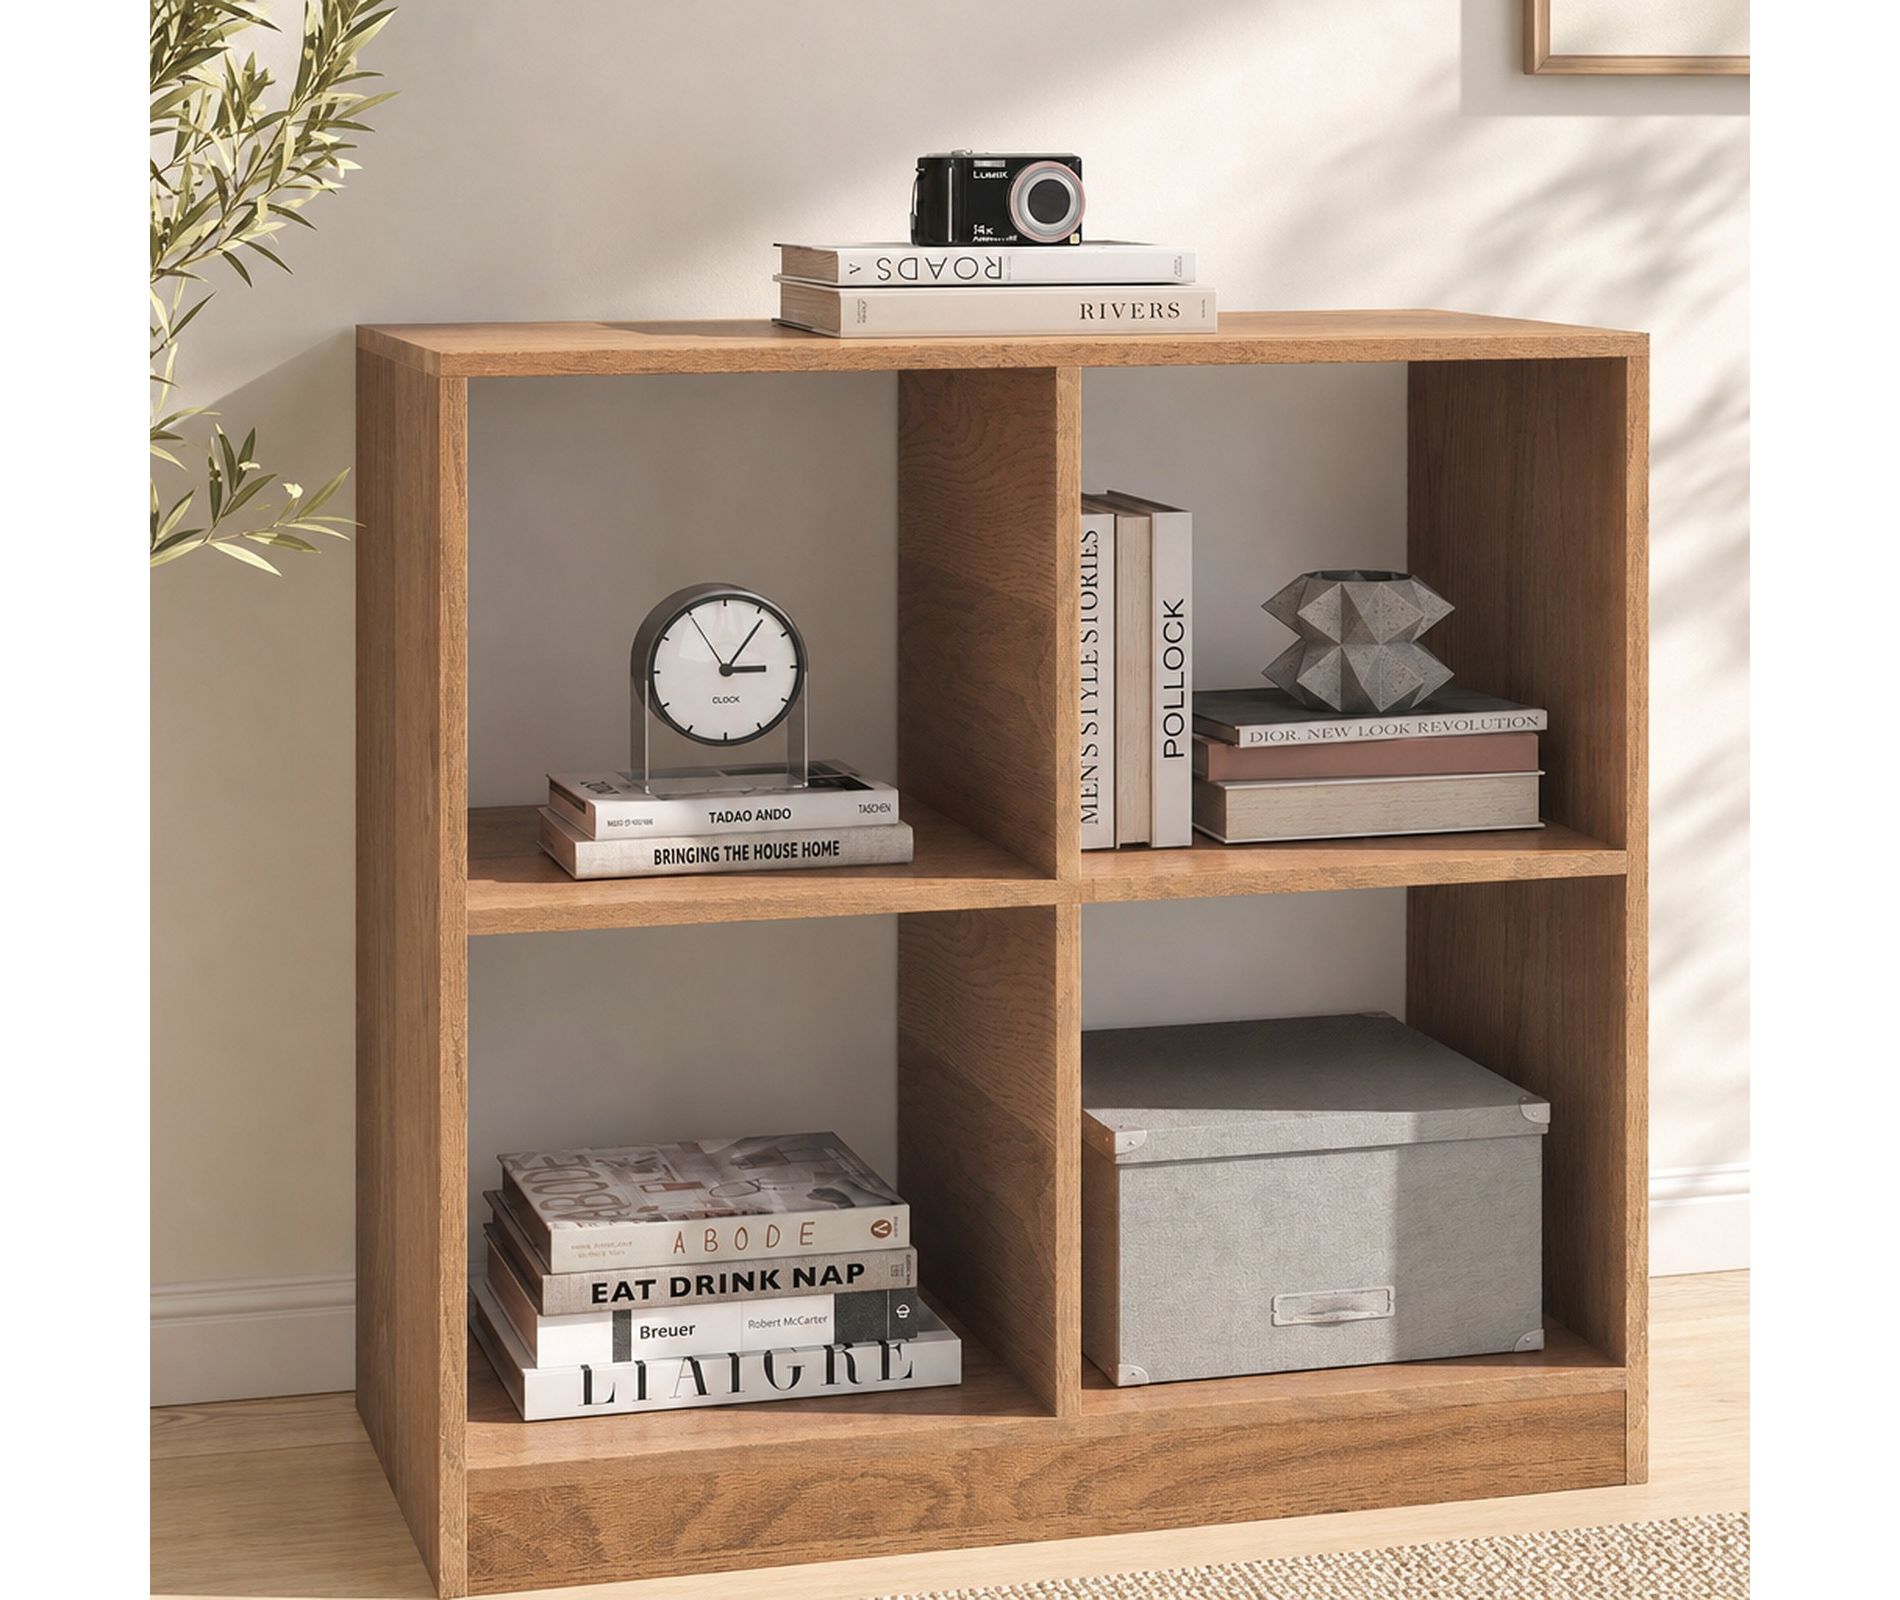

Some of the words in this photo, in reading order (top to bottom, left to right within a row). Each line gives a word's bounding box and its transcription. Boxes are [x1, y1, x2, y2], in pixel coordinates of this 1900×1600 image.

[876, 256, 1002, 281] ROADS
[1079, 302, 1181, 320] RIVERS
[1163, 598, 1185, 758] POLLOCK
[711, 695, 741, 704] CLOCK
[1250, 729, 1301, 743] DIOR.
[1308, 726, 1353, 739] NEW
[1358, 722, 1410, 737] LOOK
[1418, 716, 1539, 734] REVOLUTION
[709, 810, 752, 823] TADAO
[756, 808, 791, 821] ANDO
[654, 846, 720, 866] BRINGING
[724, 844, 749, 861] THE
[753, 842, 798, 860] HOUSE
[802, 840, 840, 857] HOME
[673, 1221, 816, 1254] ABODE
[591, 1279, 656, 1304] EAT
[670, 1268, 781, 1298] DRINK
[793, 1263, 865, 1288] NAP
[639, 1323, 696, 1340] Breuer
[748, 1318, 781, 1329] Robert
[784, 1315, 828, 1326] McCarter
[578, 1339, 914, 1406] LIAIGRE
